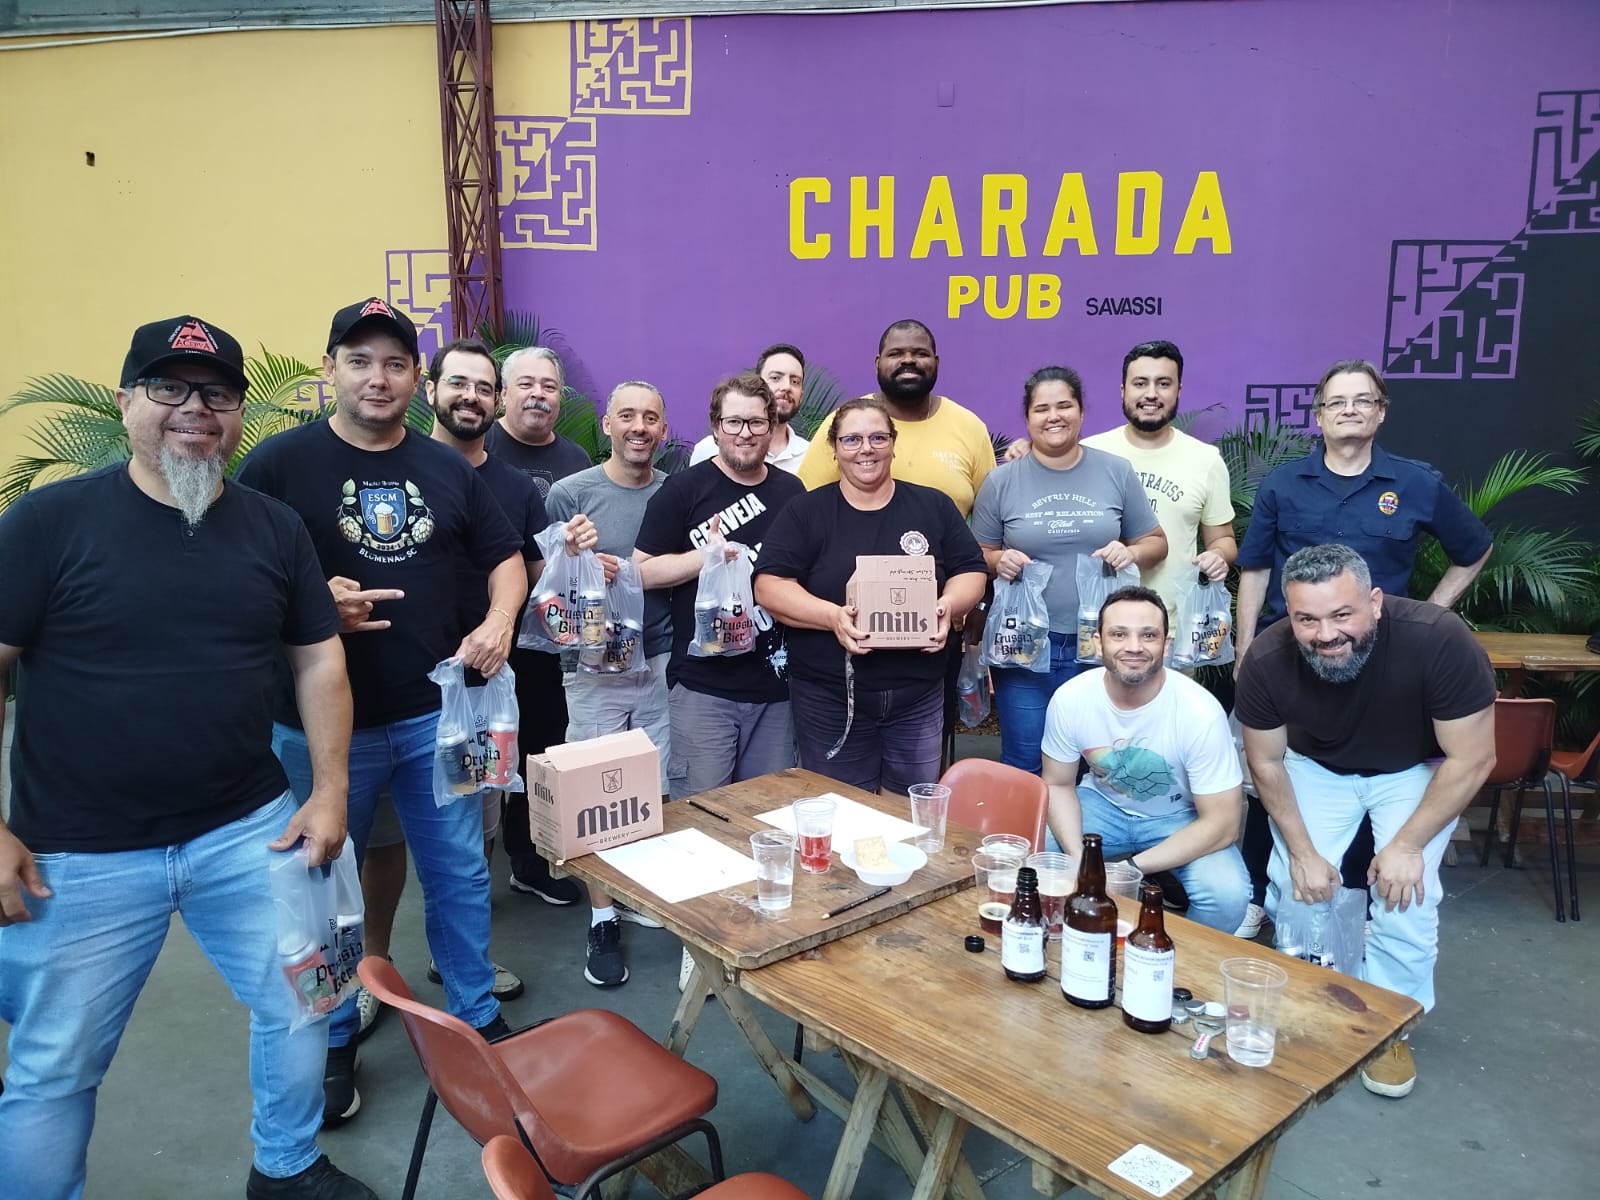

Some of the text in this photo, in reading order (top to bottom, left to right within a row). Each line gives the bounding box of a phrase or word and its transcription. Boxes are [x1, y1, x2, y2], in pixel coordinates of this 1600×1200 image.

[789, 171, 1232, 259] CHARADA
[948, 274, 1062, 319] PUB
[1086, 297, 1162, 316] SAVASSI
[367, 493, 397, 502] ESCM
[1136, 471, 1184, 502] TRAUSS
[1031, 493, 1097, 510] BEVERLY HILLS
[868, 611, 928, 633] Mills
[576, 796, 651, 839] Mills
[599, 832, 630, 844] BREWERY
